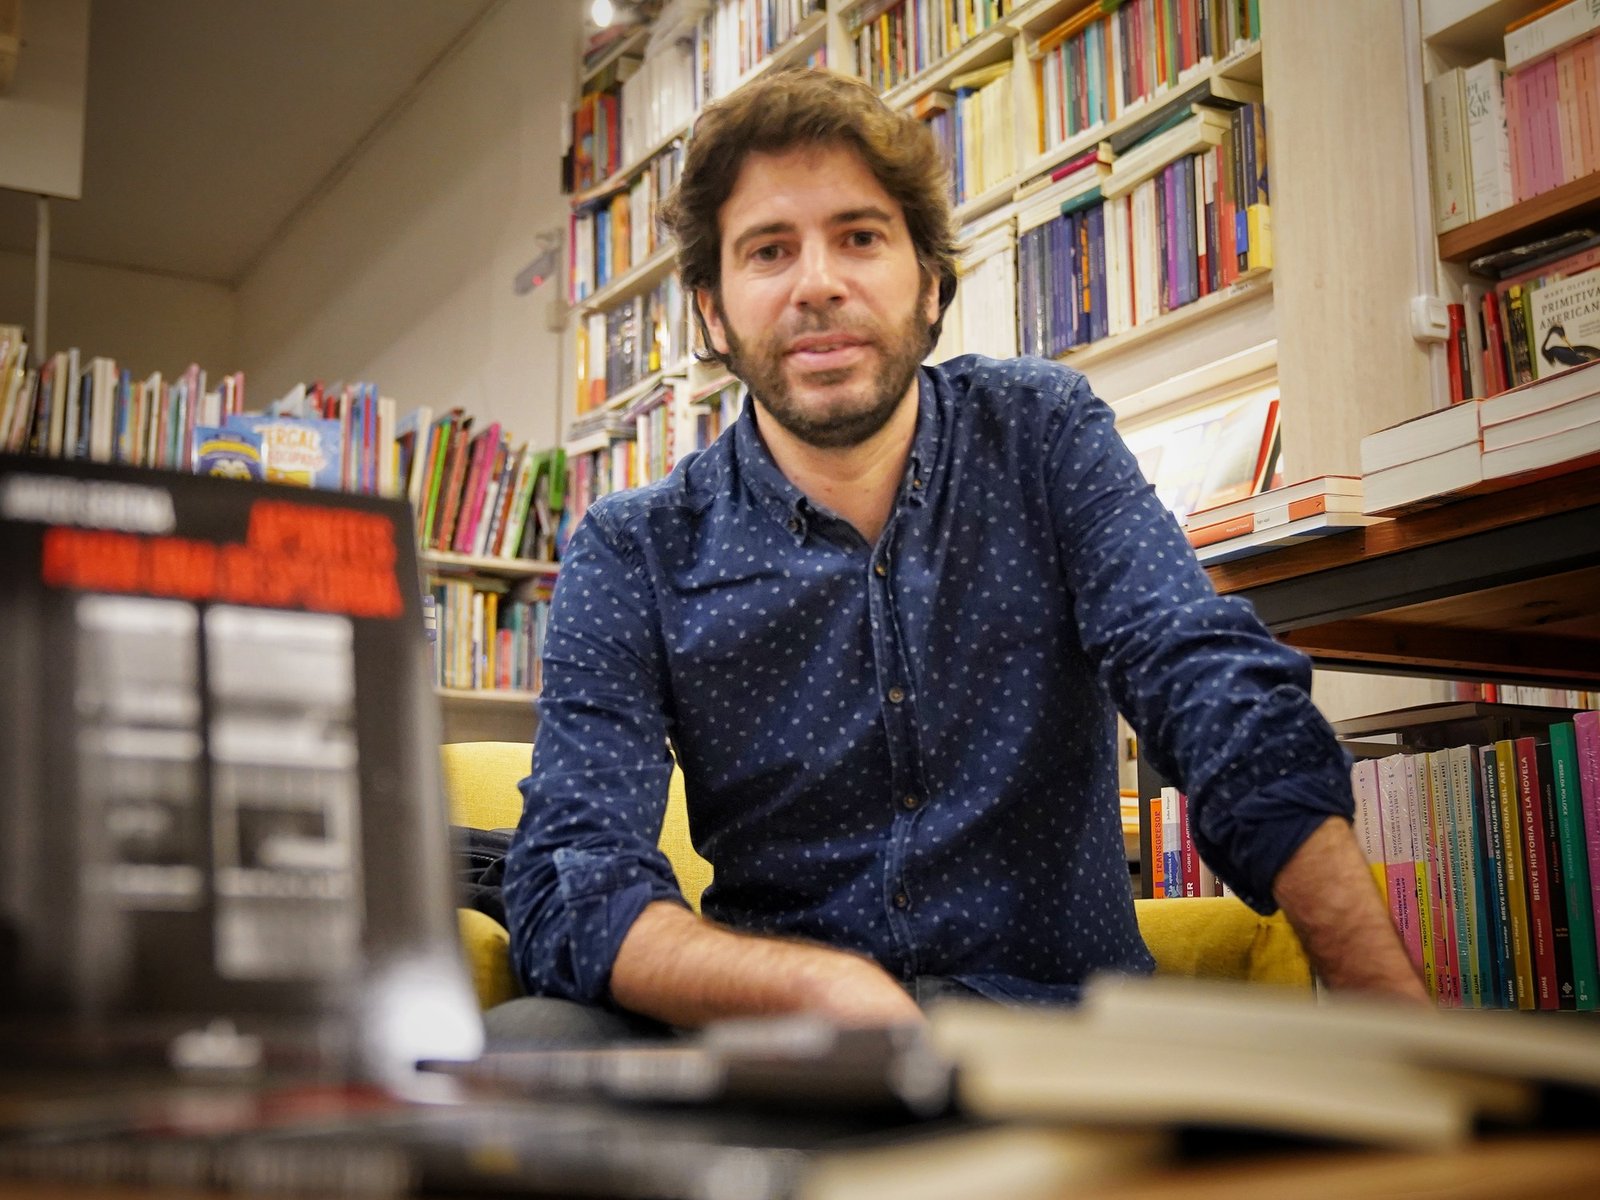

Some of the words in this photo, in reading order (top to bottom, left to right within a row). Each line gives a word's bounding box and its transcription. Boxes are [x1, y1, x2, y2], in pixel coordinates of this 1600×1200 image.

[1487, 764, 1495, 799] ARTISTAS
[1521, 757, 1530, 794] NOVELA
[1557, 759, 1565, 788] GRISELDA
[1525, 796, 1532, 809] LA
[1526, 809, 1533, 823] DE
[1155, 811, 1163, 873] TRANSGRESOR
[1503, 806, 1511, 849] HISTORIA
[1495, 849, 1500, 860] DE
[1527, 825, 1537, 869] HISTORIA
[1457, 830, 1468, 900] TRASCENDENTALES
[1496, 861, 1504, 895] HISTORIA
[1531, 869, 1540, 901] BREVE
[1464, 902, 1472, 945] MOMENTOS
